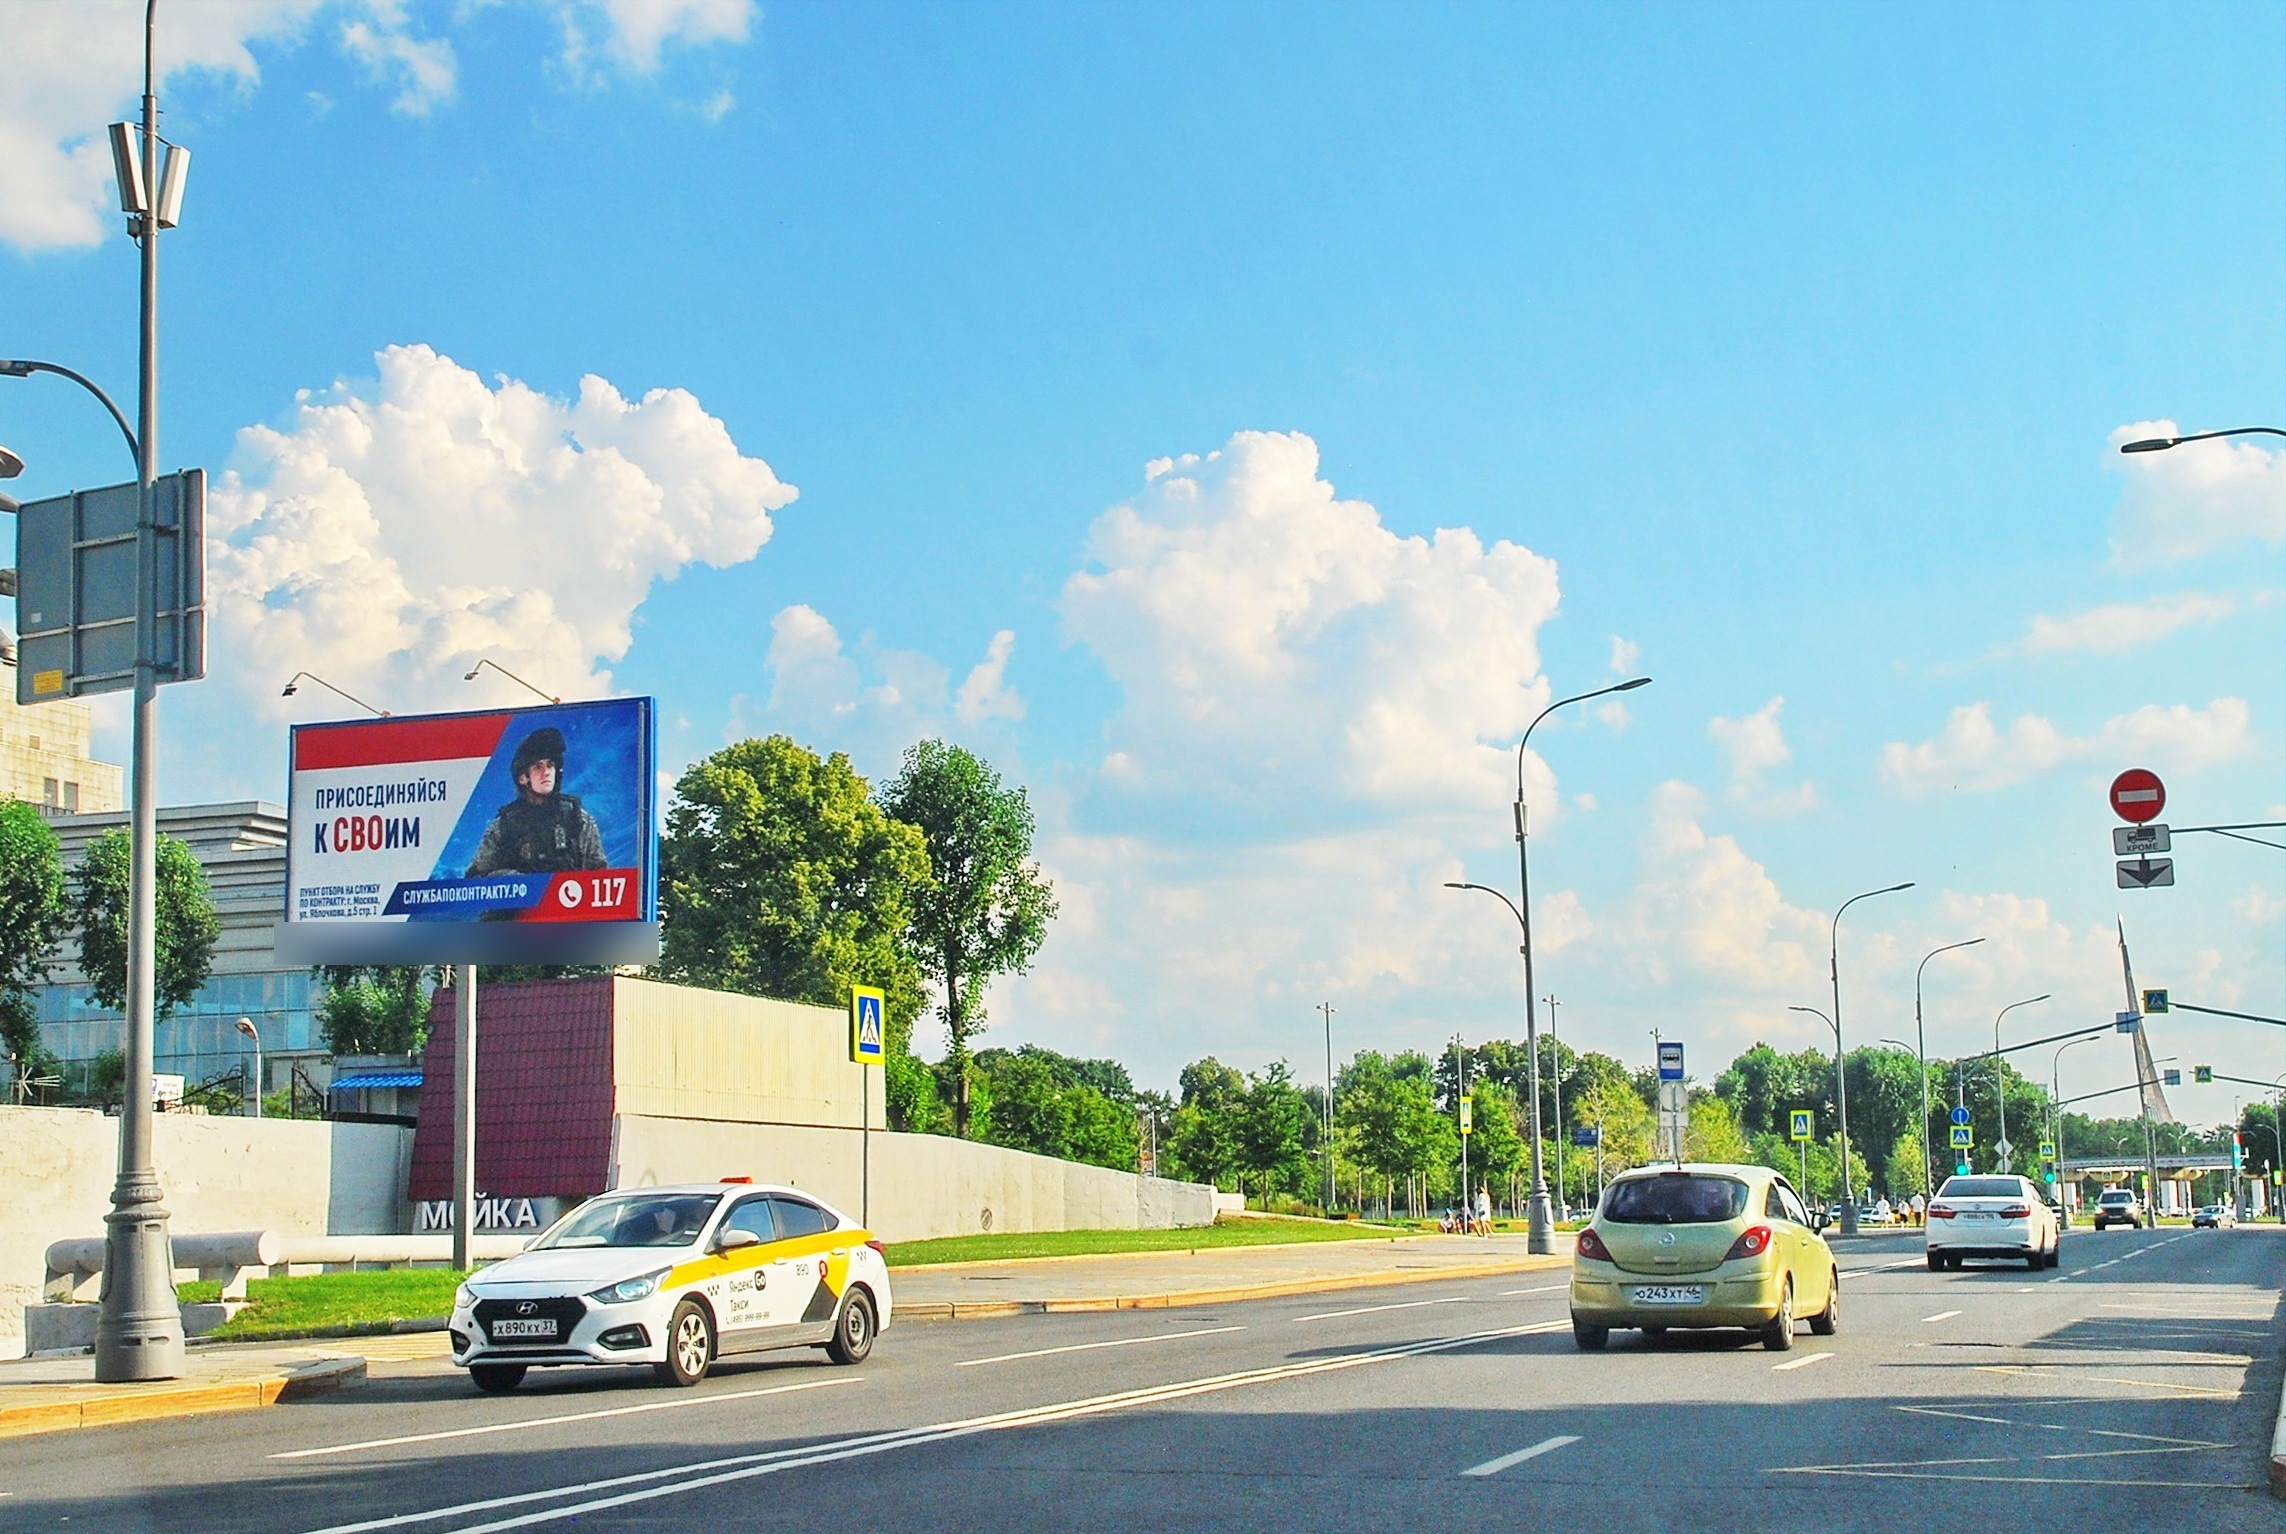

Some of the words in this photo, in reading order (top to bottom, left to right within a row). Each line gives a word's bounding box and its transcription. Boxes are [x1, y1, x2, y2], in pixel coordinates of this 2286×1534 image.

[315, 777, 447, 810] ПРИСОЕДИНЯЙСЯ
[314, 822, 328, 854] К
[333, 814, 420, 853] СВОИМ
[2126, 842, 2159, 852] КРОМЕ
[300, 887, 320, 897] ПУНКТ
[321, 886, 344, 896] ОТБОРА
[345, 885, 354, 895] НА
[354, 883, 380, 894] СЛУЖБУ
[403, 884, 528, 905] СЛУЖБАПОКОНТРАКТУ.РФ
[591, 877, 627, 908] 117
[299, 898, 309, 908] ПО
[309, 896, 346, 907] КОНТРАКТУ:
[353, 896, 380, 905] Москва,
[299, 911, 308, 920] ул.
[421, 1191, 538, 1230] МЙКА
[796, 1263, 809, 1276] 890
[729, 1279, 754, 1293] Яндекс
[729, 1299, 749, 1312] Такси
[543, 1320, 554, 1331] 37
